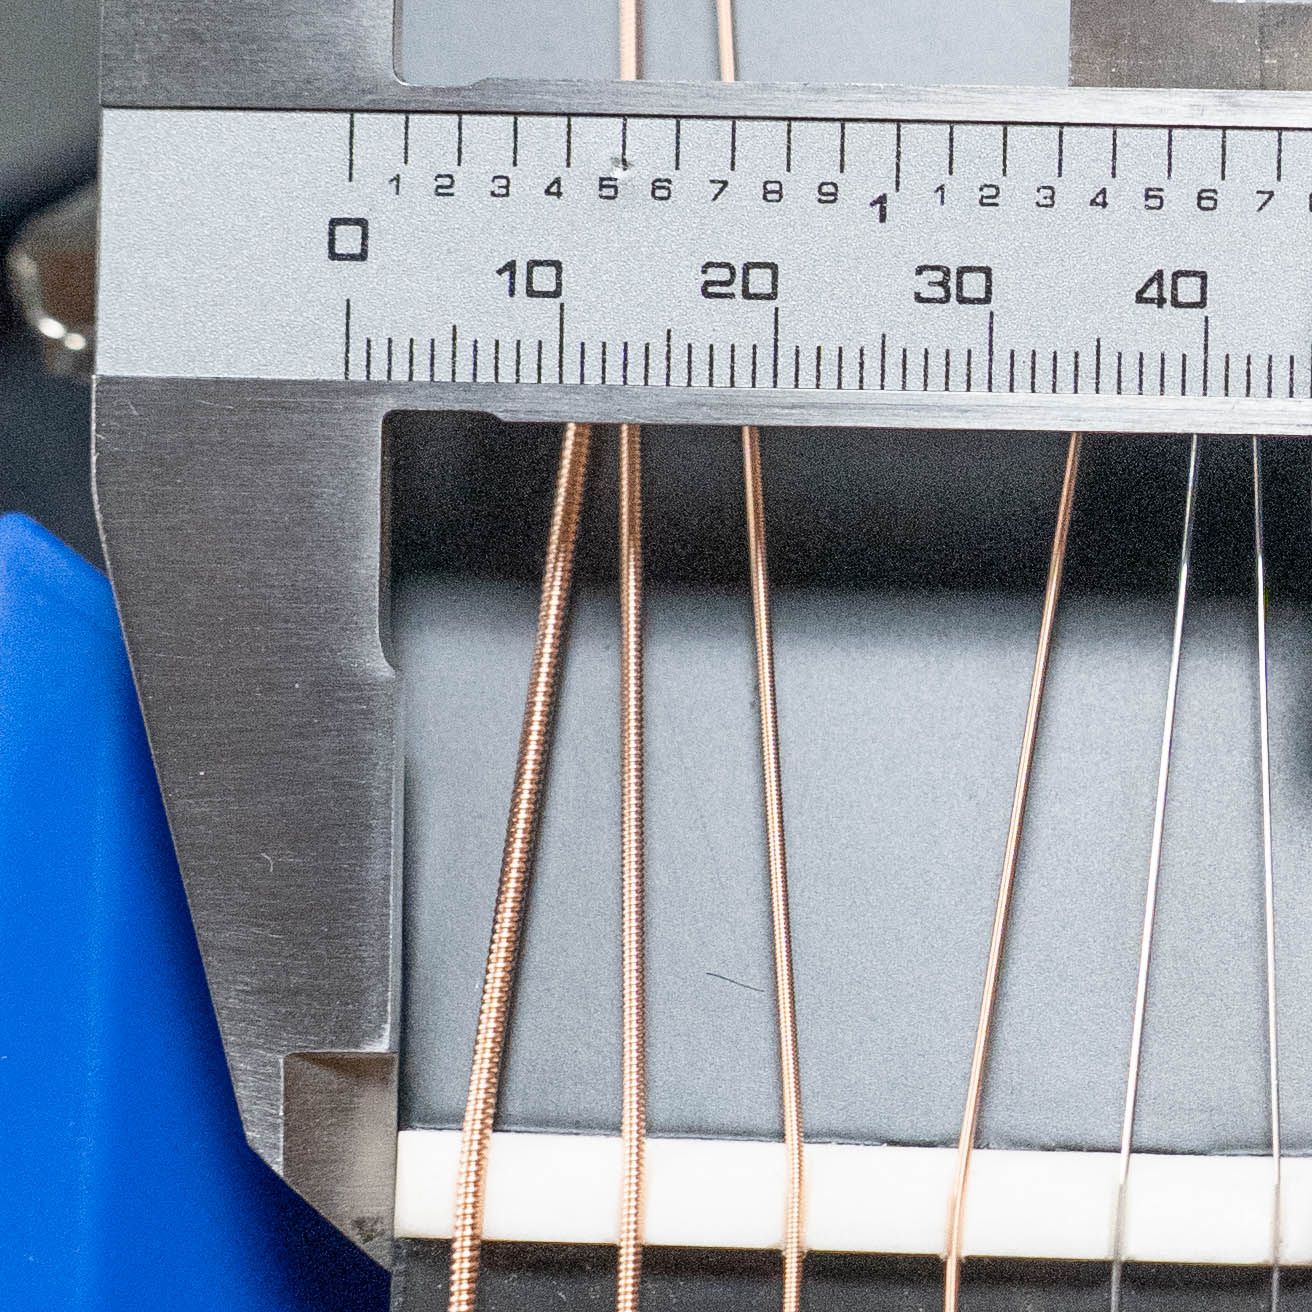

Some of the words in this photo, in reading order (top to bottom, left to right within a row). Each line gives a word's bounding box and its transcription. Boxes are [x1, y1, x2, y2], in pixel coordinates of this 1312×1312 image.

[389, 174, 402, 196] 1
[433, 173, 456, 198] 2
[489, 175, 512, 199] 3
[543, 176, 564, 200] 4
[597, 175, 620, 202] 5
[649, 177, 673, 202] 6
[709, 178, 730, 202] 7
[761, 180, 784, 204] 8
[816, 180, 840, 205] 9
[868, 192, 889, 225] 1
[933, 183, 946, 206] 1
[978, 183, 1001, 208] 2
[1035, 184, 1057, 209] 3
[1088, 186, 1109, 210] 4
[1143, 186, 1165, 211] 5
[1195, 187, 1219, 213] 6
[1255, 189, 1275, 213] 7
[327, 216, 370, 263] 0
[495, 258, 564, 300] 10
[699, 260, 780, 302] 20
[913, 263, 994, 306] 30
[1134, 268, 1209, 309] 40
